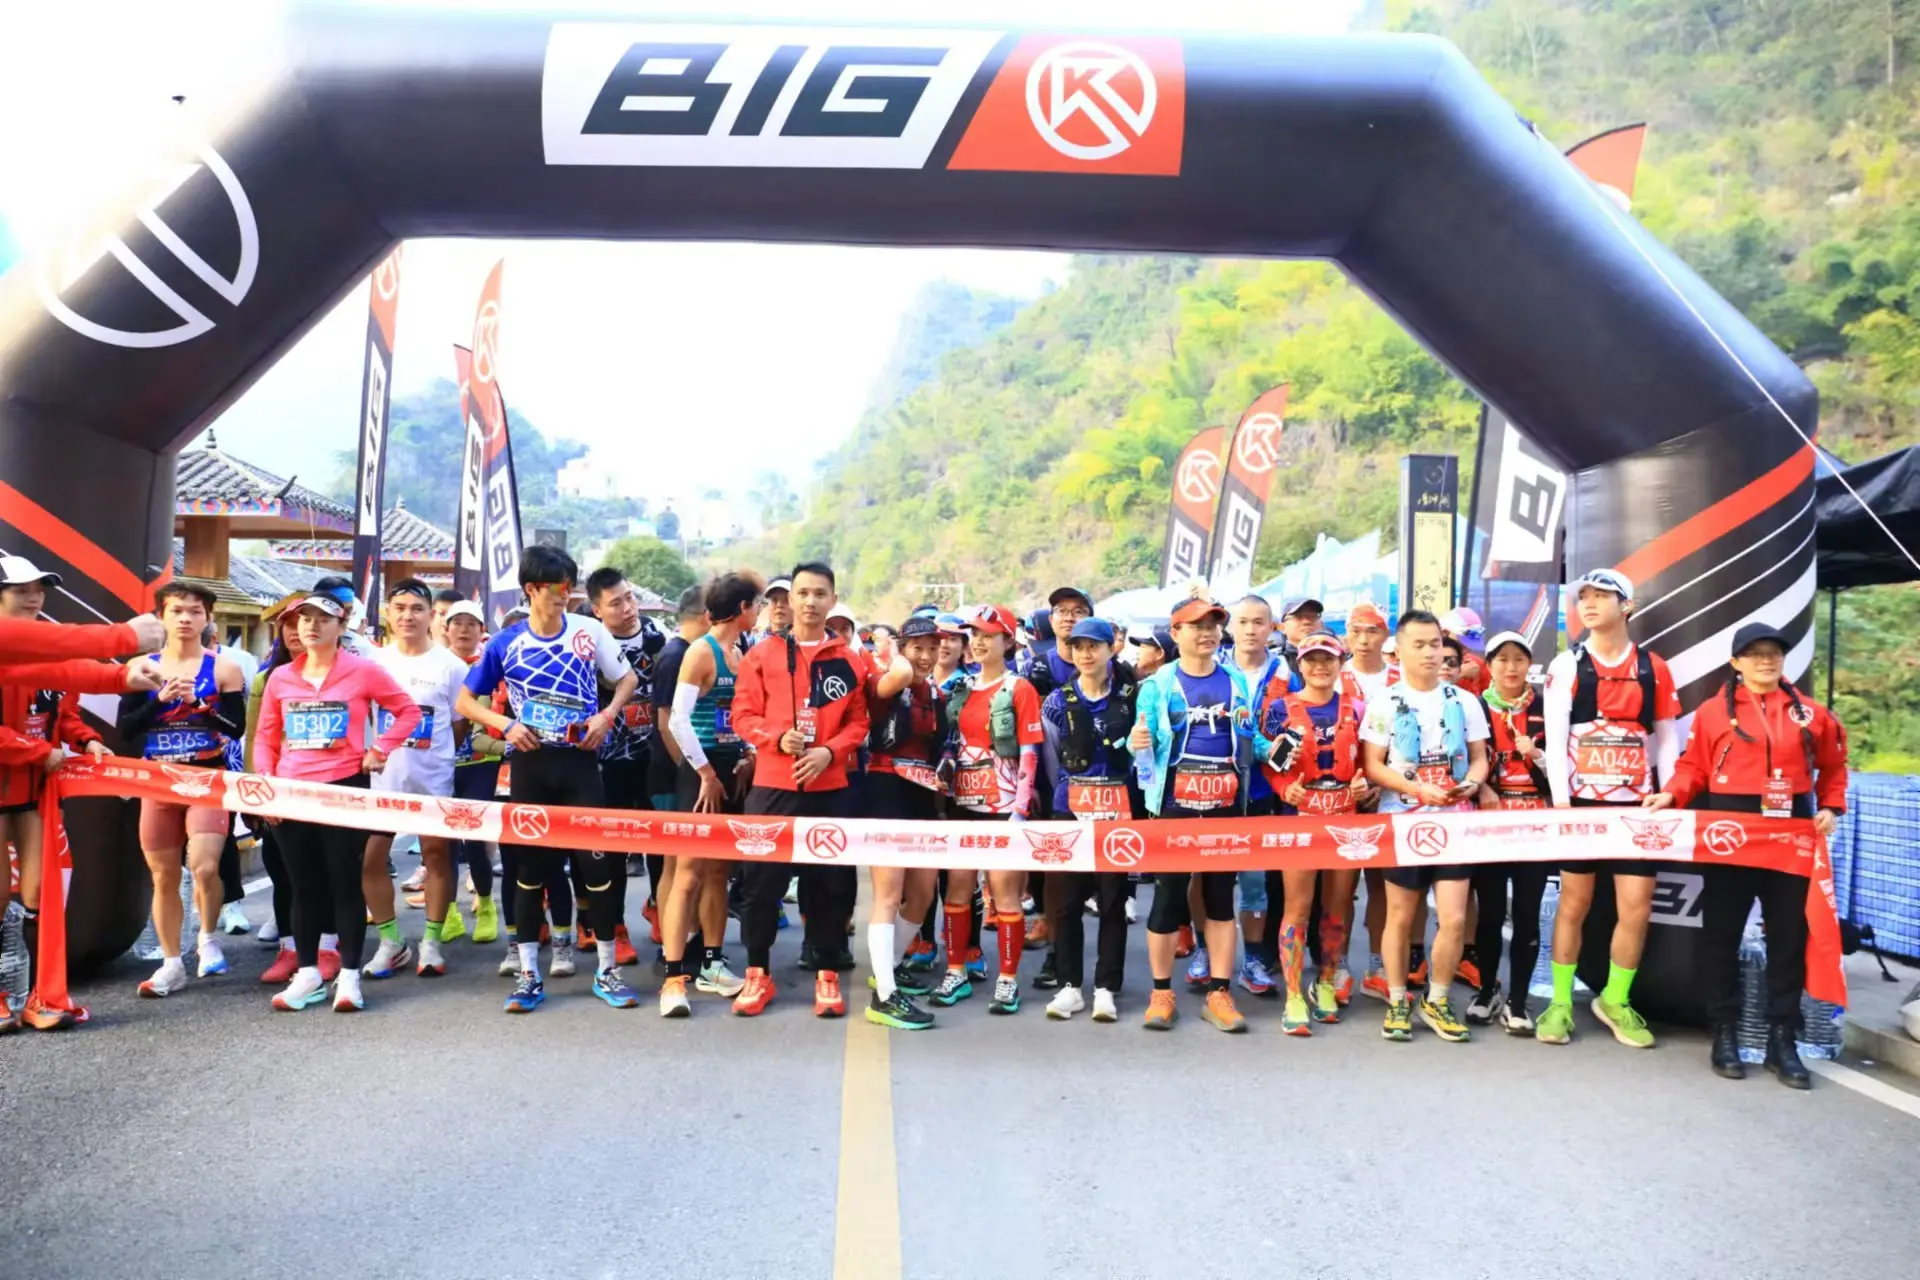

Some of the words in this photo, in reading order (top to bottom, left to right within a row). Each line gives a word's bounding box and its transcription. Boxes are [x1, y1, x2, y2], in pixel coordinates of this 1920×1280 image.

[580, 42, 951, 138] BIG
[1229, 508, 1254, 562] IG
[1171, 533, 1194, 580] IG
[293, 713, 343, 734] B302
[532, 704, 580, 728] B362
[157, 732, 209, 750] B365
[1587, 748, 1640, 769] A042
[1078, 786, 1121, 807] A101
[1185, 776, 1232, 795] A001
[1307, 787, 1353, 810] A022
